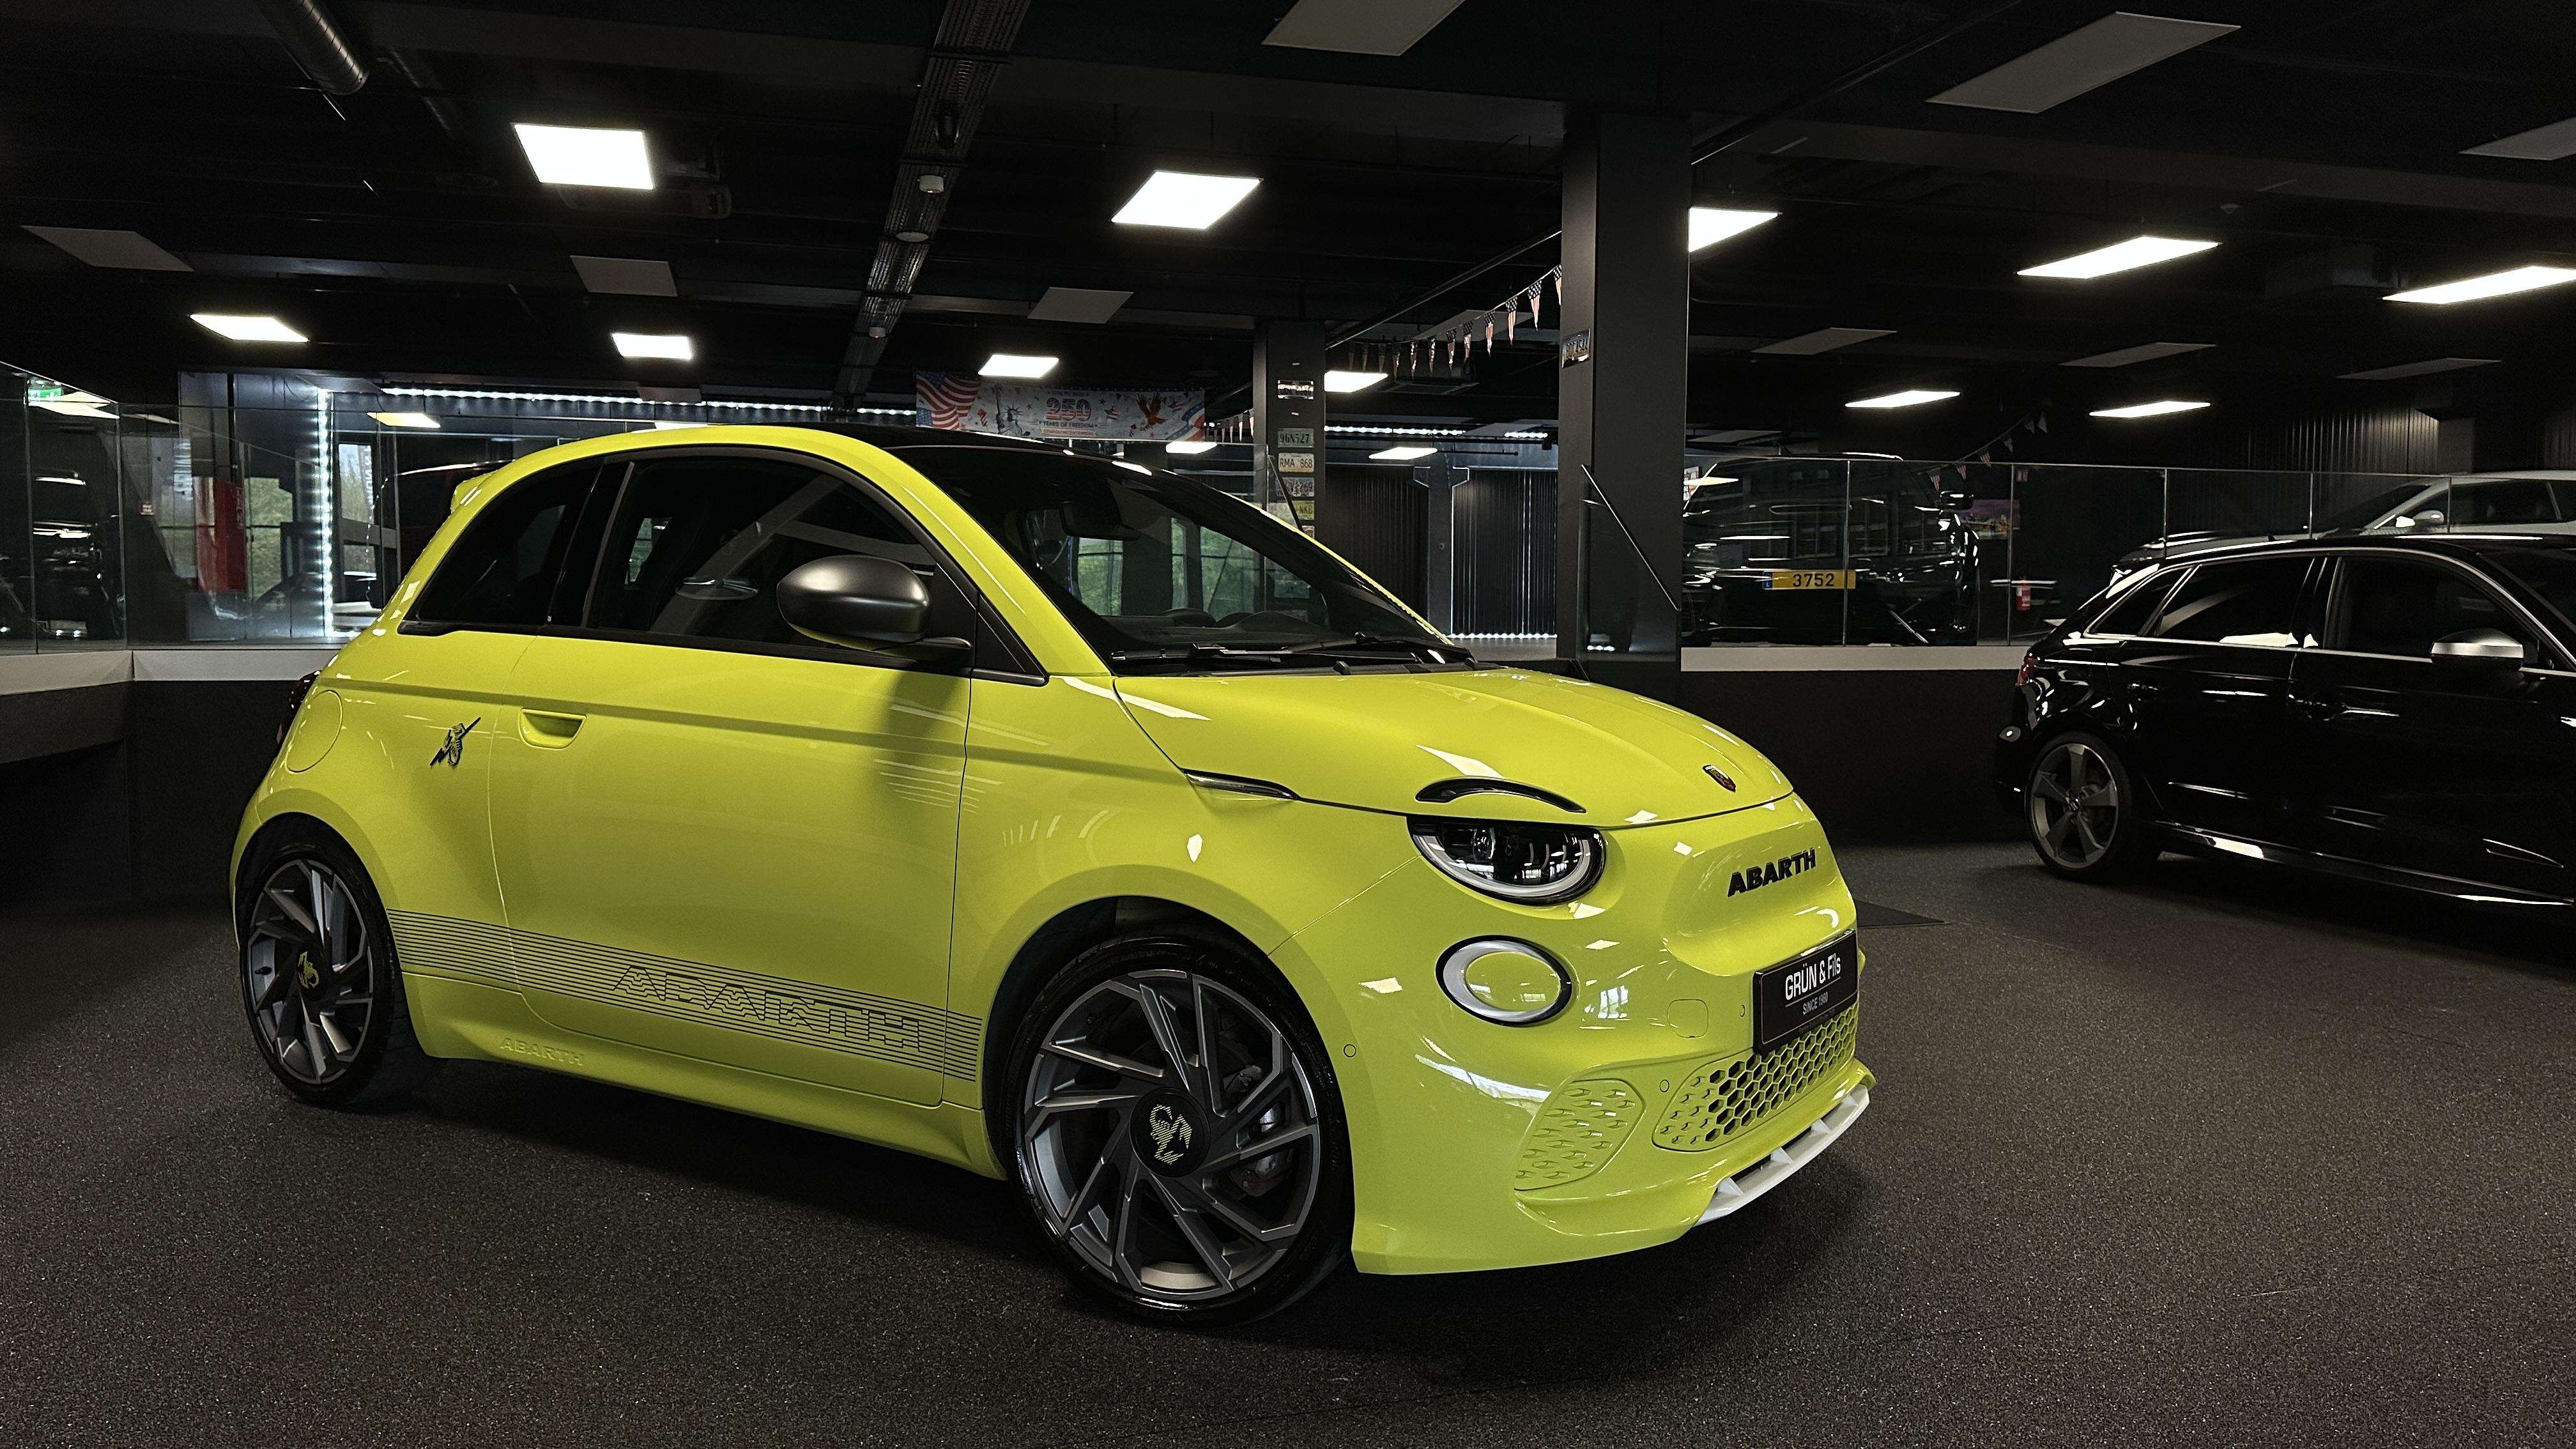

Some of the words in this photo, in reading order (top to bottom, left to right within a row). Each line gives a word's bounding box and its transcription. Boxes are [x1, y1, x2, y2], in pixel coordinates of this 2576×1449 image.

[1046, 397, 1091, 421] 250
[1280, 458, 1295, 468] RMA
[1793, 573, 1835, 587] 3752
[1728, 848, 1816, 897] ABARTH
[1785, 963, 1817, 1000] GRÜN
[1819, 960, 1826, 985] &
[1828, 953, 1841, 980] Fils
[612, 963, 924, 1054] ABARTH
[1802, 997, 1818, 1015] SINCE
[498, 1036, 586, 1068] ABARTH
